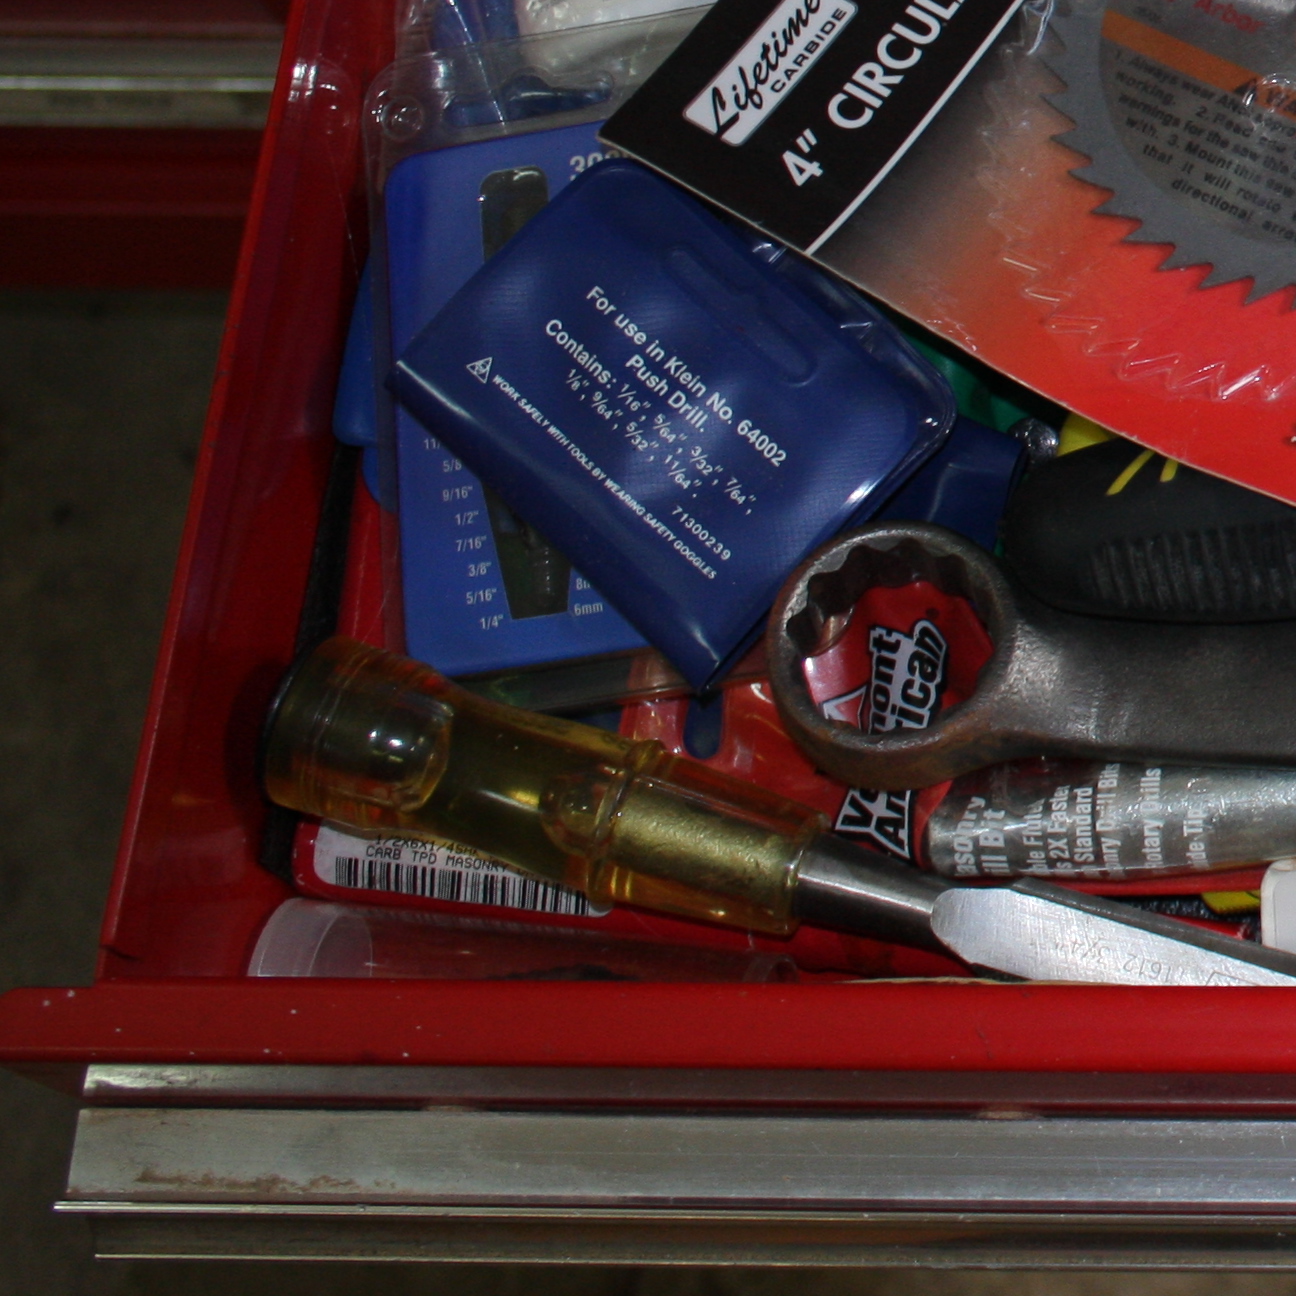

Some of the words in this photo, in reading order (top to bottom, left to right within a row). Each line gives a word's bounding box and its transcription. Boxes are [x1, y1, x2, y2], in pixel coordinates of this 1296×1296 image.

[769, 4, 847, 96] CARBIDE
[774, 126, 838, 191] 4"
[541, 316, 621, 389] Contains:
[585, 284, 619, 317] For
[612, 313, 649, 347] use
[643, 339, 668, 363] in
[663, 354, 709, 398] Klein
[705, 391, 740, 424] No.
[734, 417, 788, 467] 64002
[623, 352, 671, 397] Push
[666, 389, 712, 432] Drill.
[442, 486, 473, 501] 9/16"
[491, 373, 520, 401] WORK
[516, 396, 550, 428] SAFELY
[546, 423, 570, 446] WITH
[565, 442, 595, 470] TOOLS
[591, 466, 606, 481] BY
[603, 477, 646, 516] WEARING
[641, 511, 676, 543] SAFETY
[672, 539, 717, 580] GOGGLES
[454, 510, 479, 525] 1/2"
[670, 505, 732, 561] 71300239
[455, 535, 487, 552] 7/16"
[468, 561, 491, 577] 3/8"
[465, 588, 497, 604] 5/16"
[573, 601, 603, 615] 6mm
[479, 614, 504, 630] 1/4"
[977, 807, 1008, 848] Bit
[1073, 786, 1093, 861] Standard
[365, 845, 401, 860] CARB
[411, 850, 436, 864] TPD
[445, 855, 508, 873] MASONRY
[1045, 836, 1071, 860] 2X
